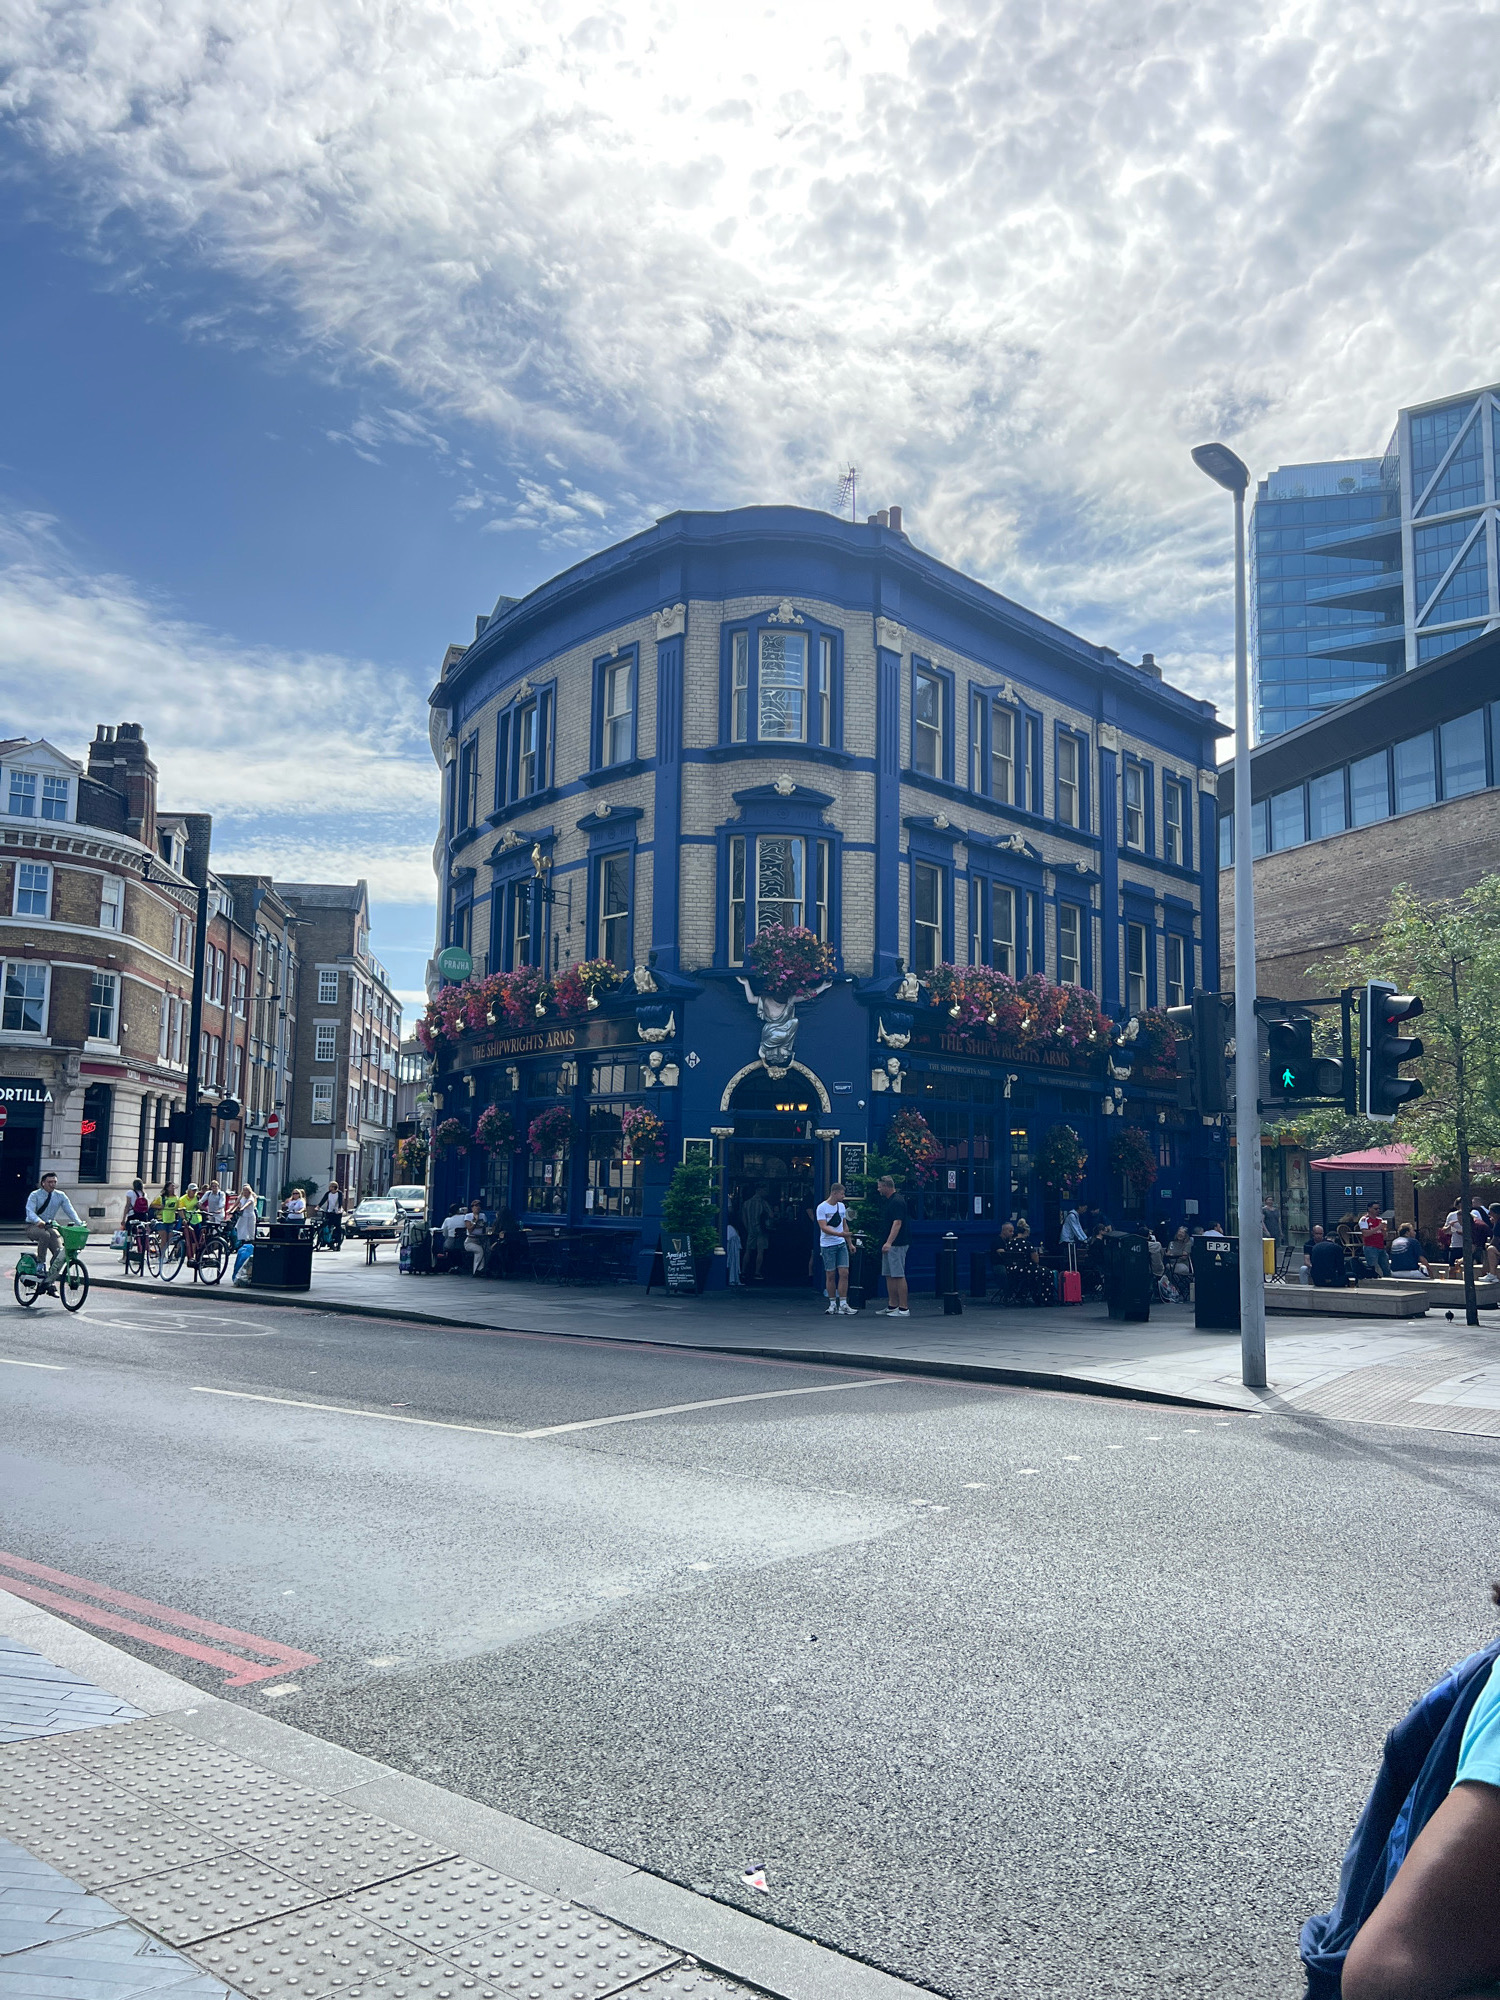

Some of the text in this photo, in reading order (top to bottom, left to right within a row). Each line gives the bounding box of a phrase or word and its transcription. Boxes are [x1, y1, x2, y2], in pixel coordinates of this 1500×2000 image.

[444, 960, 469, 971] PRAJHA
[472, 1029, 575, 1060] THE SHIPWRIGHTS ARMS
[939, 1033, 963, 1051] THE
[965, 1038, 1040, 1064] SHIPWRIGHTS
[1042, 1050, 1070, 1068] ARMS
[928, 1063, 939, 1071] THE
[977, 1069, 991, 1077] ARMS
